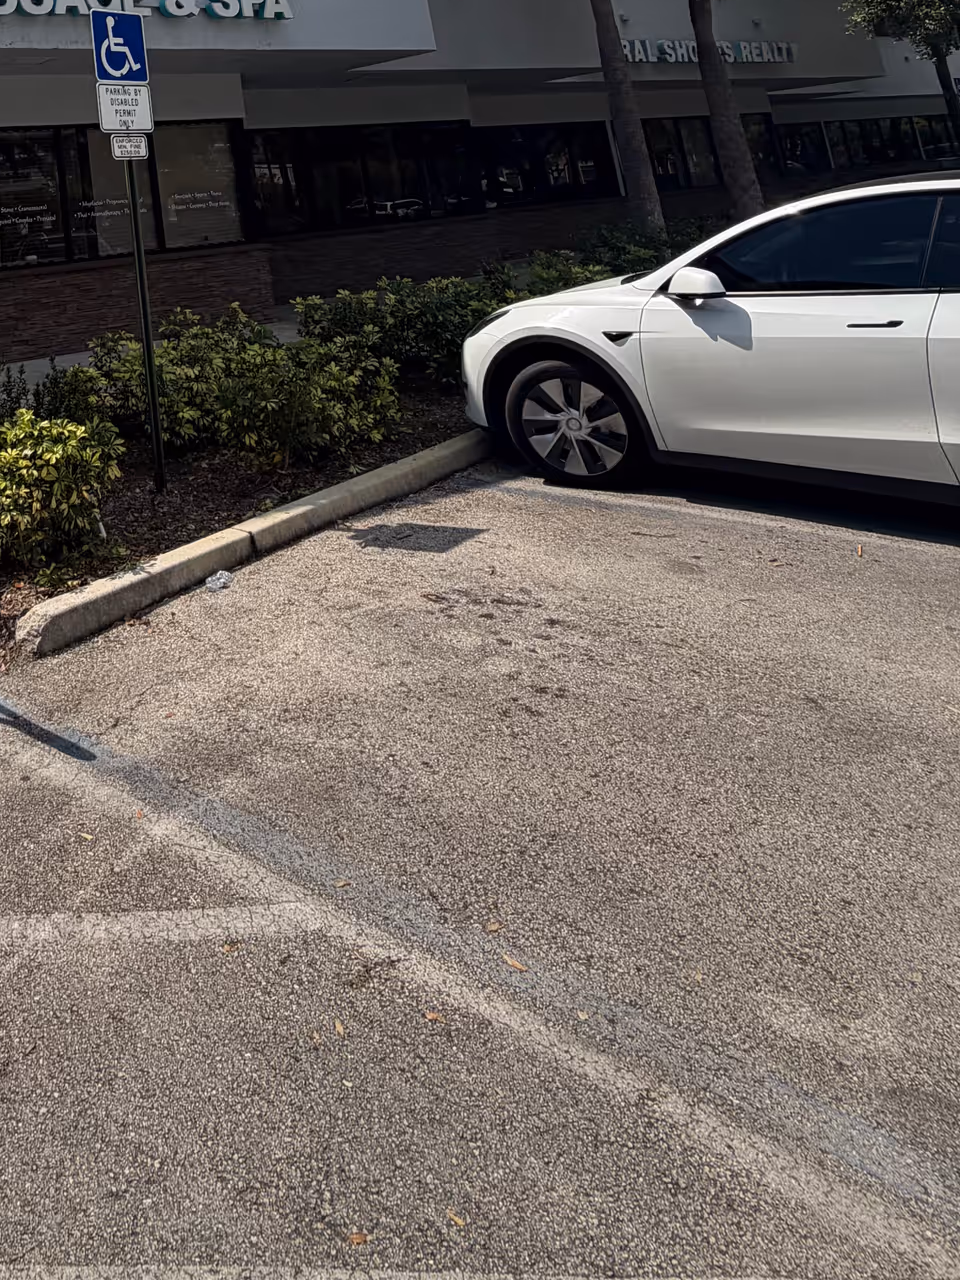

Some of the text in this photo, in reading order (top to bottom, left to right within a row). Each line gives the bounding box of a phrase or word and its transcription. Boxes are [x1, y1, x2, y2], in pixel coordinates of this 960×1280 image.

[621, 39, 799, 63] RAL SHOS REALTY
[105, 87, 142, 97] PARKING BY
[110, 98, 139, 107] DISABLED
[115, 109, 136, 118] PERMIT
[119, 119, 135, 128] ONLY
